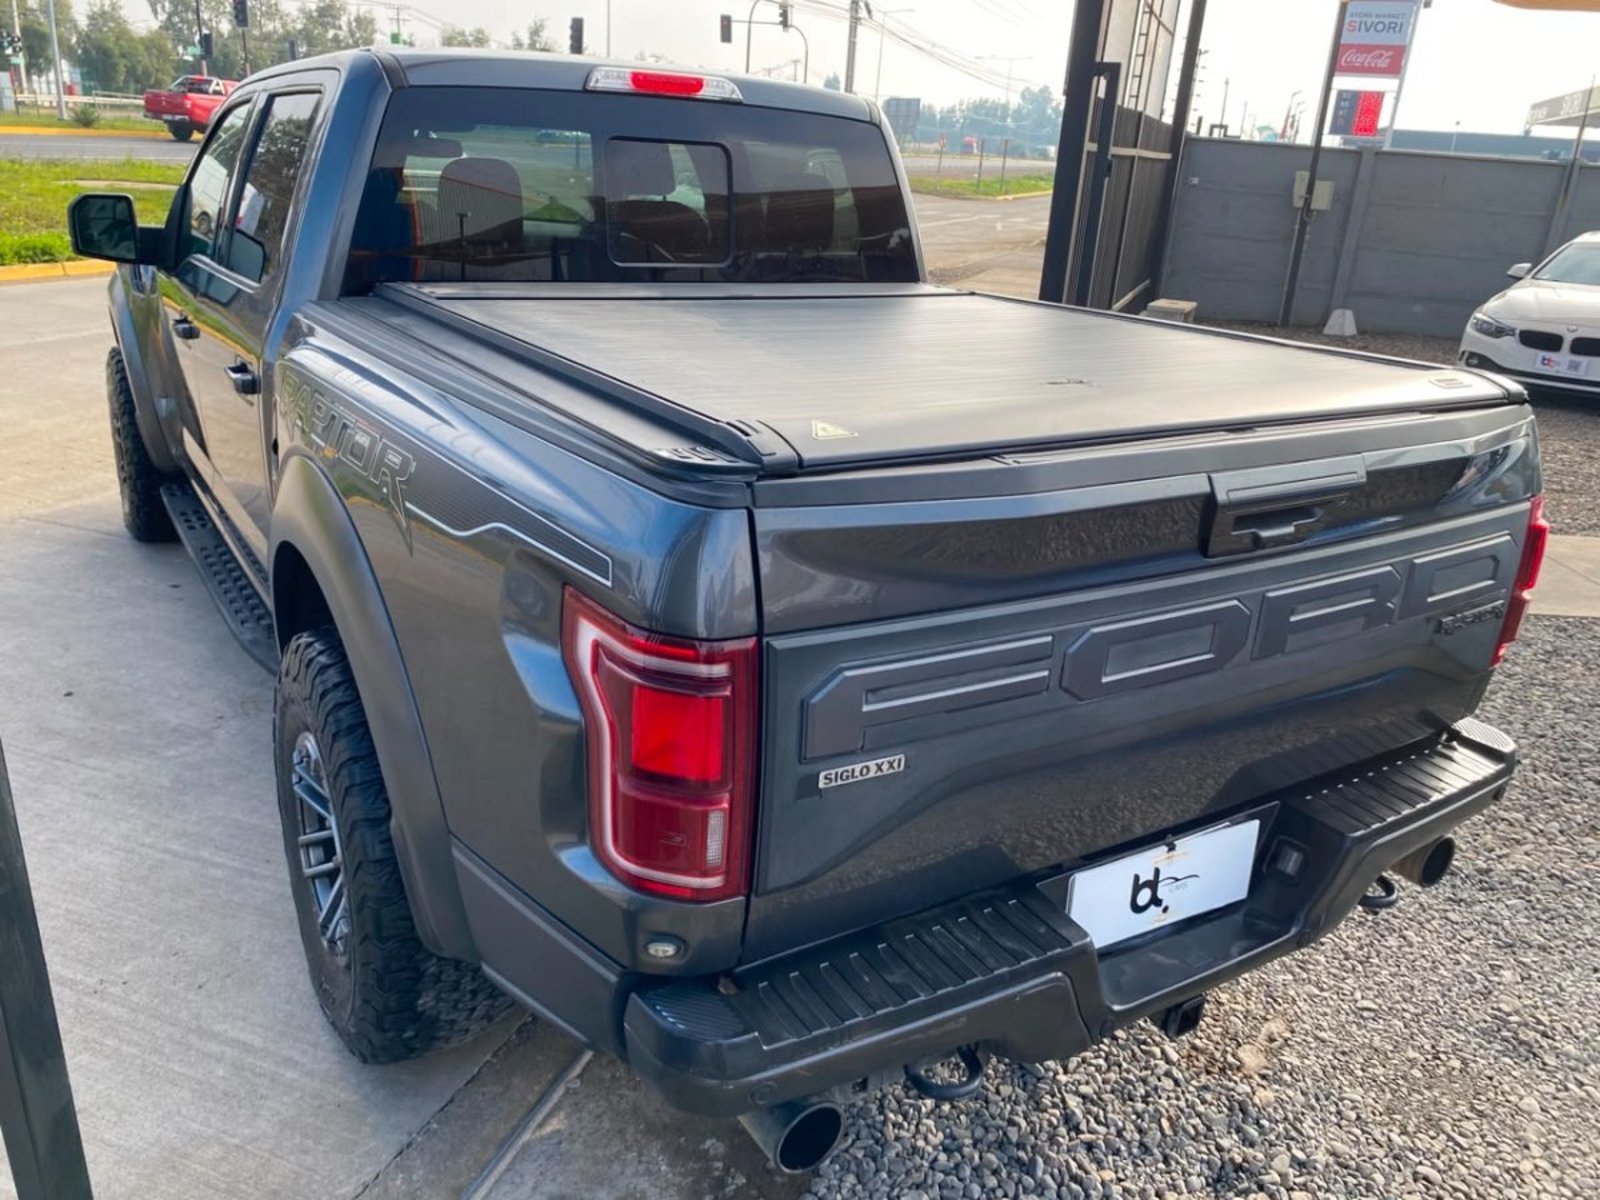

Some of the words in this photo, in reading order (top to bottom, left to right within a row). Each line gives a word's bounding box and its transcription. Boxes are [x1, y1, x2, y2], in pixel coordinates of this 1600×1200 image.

[1346, 19, 1404, 33] SIVORI
[1340, 48, 1394, 68] Coca-Cola
[803, 532, 1517, 761] FORD
[822, 765, 870, 785] SIGLO
[874, 758, 902, 774] XXI
